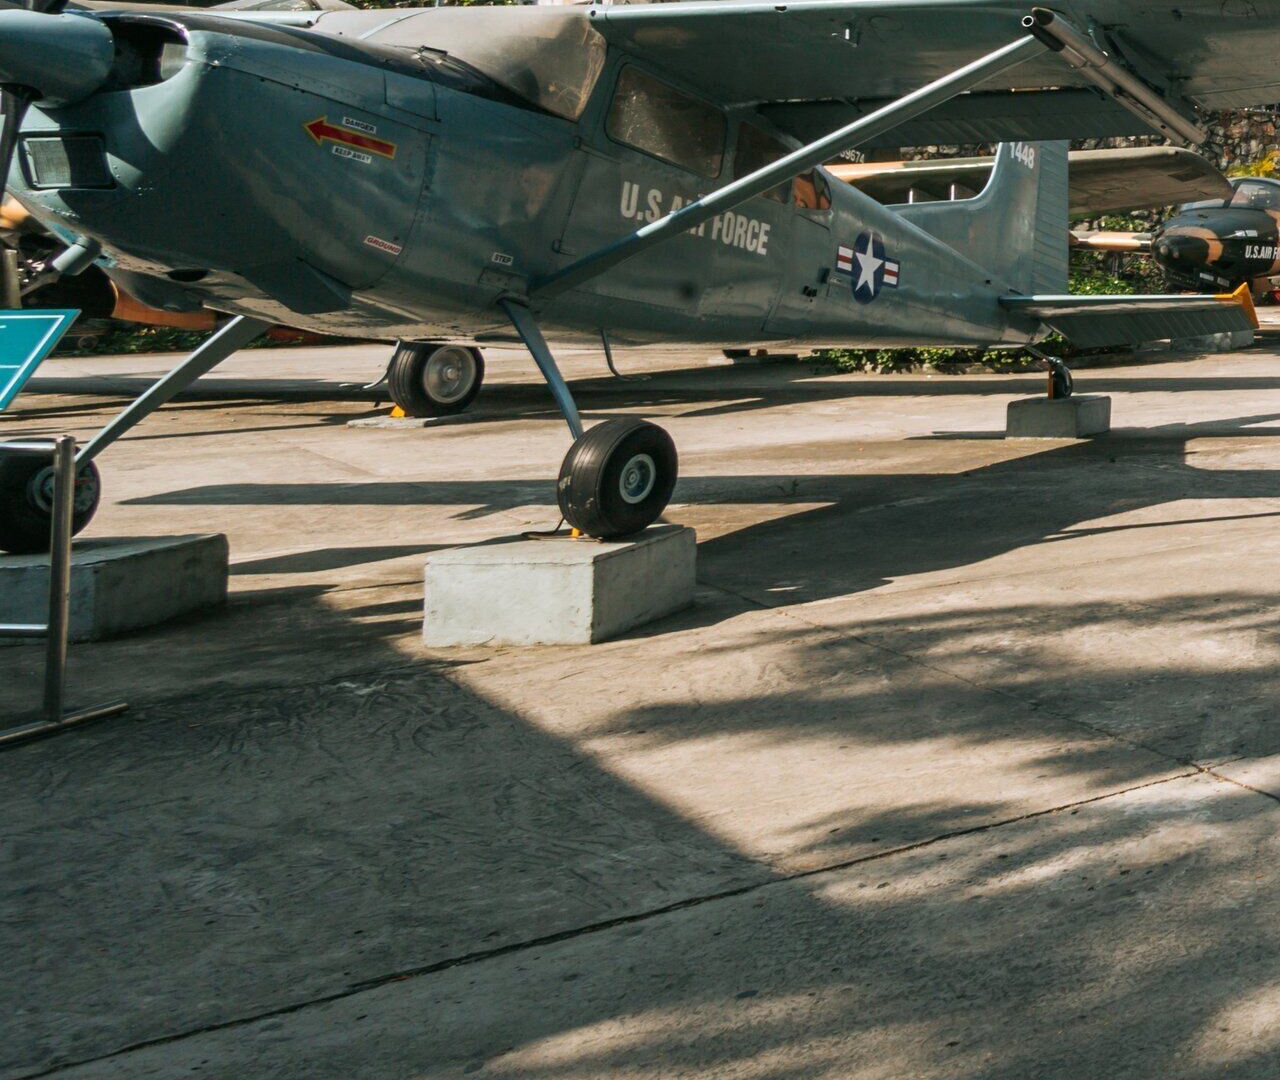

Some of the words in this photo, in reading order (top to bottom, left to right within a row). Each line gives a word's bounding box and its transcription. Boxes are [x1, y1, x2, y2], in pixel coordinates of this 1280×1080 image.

[345, 118, 375, 132] DANGER
[711, 211, 771, 256] FORCE
[367, 237, 401, 253] GROUND
[495, 253, 512, 263] STEP
